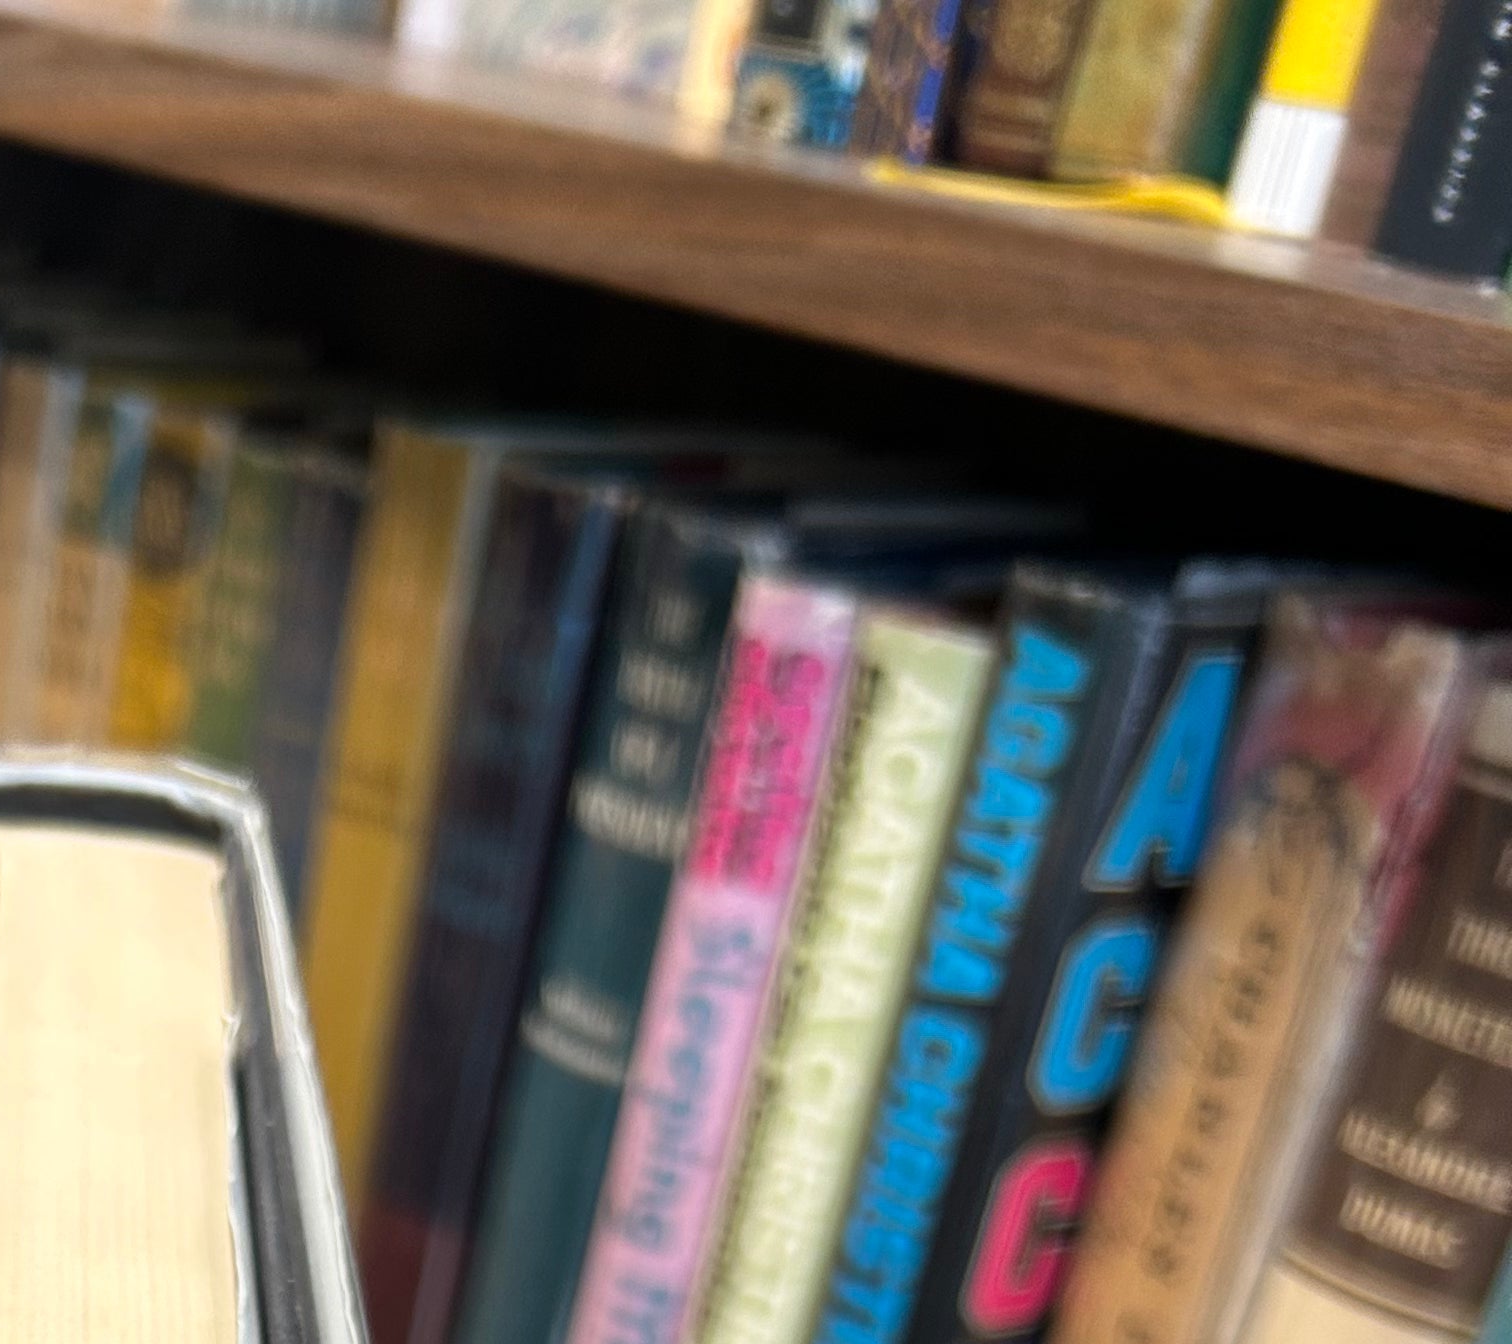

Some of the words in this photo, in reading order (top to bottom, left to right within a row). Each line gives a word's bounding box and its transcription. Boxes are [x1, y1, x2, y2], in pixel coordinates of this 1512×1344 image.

[810, 675, 950, 1015] AGATHA
[922, 622, 1084, 998] AGATHA
[612, 921, 762, 1248] Sleeping
